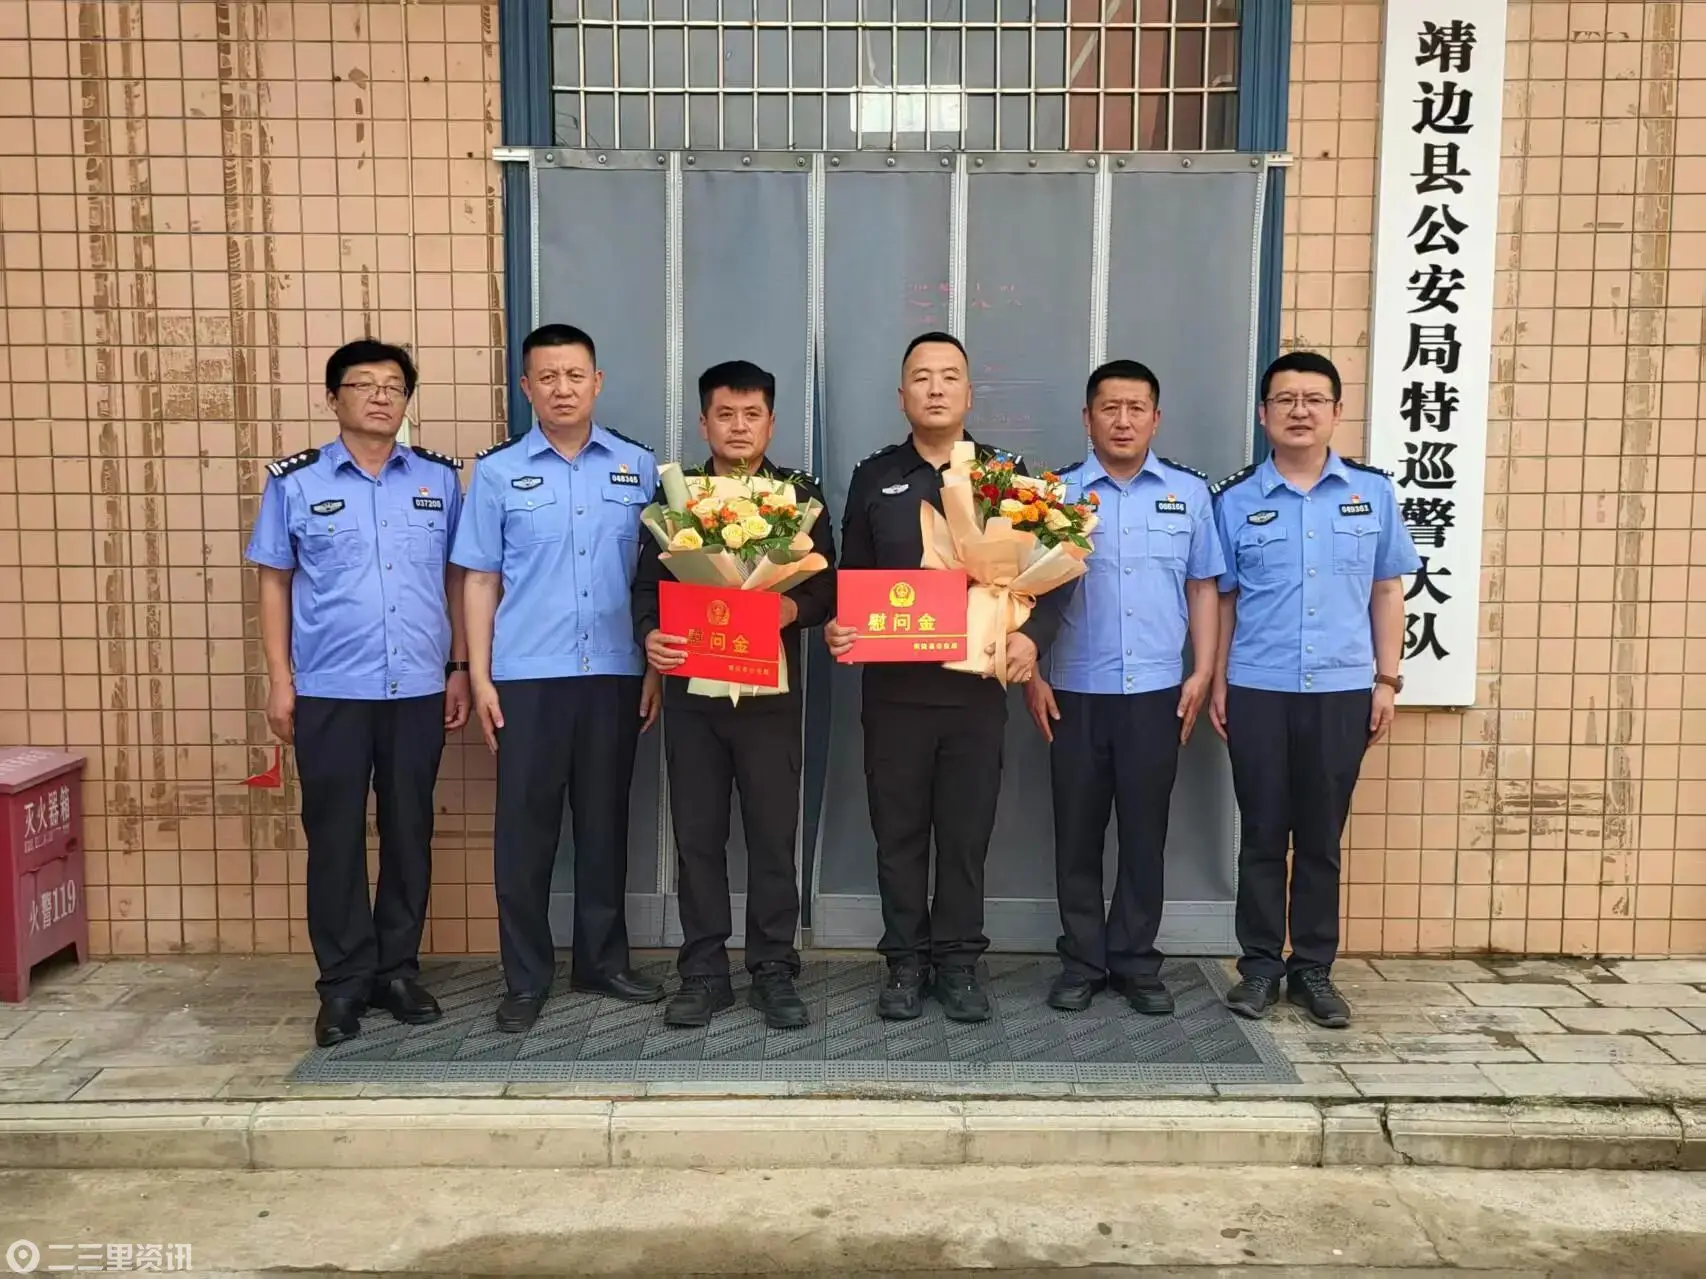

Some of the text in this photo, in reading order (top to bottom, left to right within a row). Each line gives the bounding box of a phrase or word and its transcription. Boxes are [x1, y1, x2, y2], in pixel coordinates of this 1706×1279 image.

[1397, 20, 1477, 661] 靖边县公安局特巡警大队
[868, 612, 936, 632] 慰问金
[24, 784, 71, 839] 灭火器箱
[29, 879, 77, 936] 火警119
